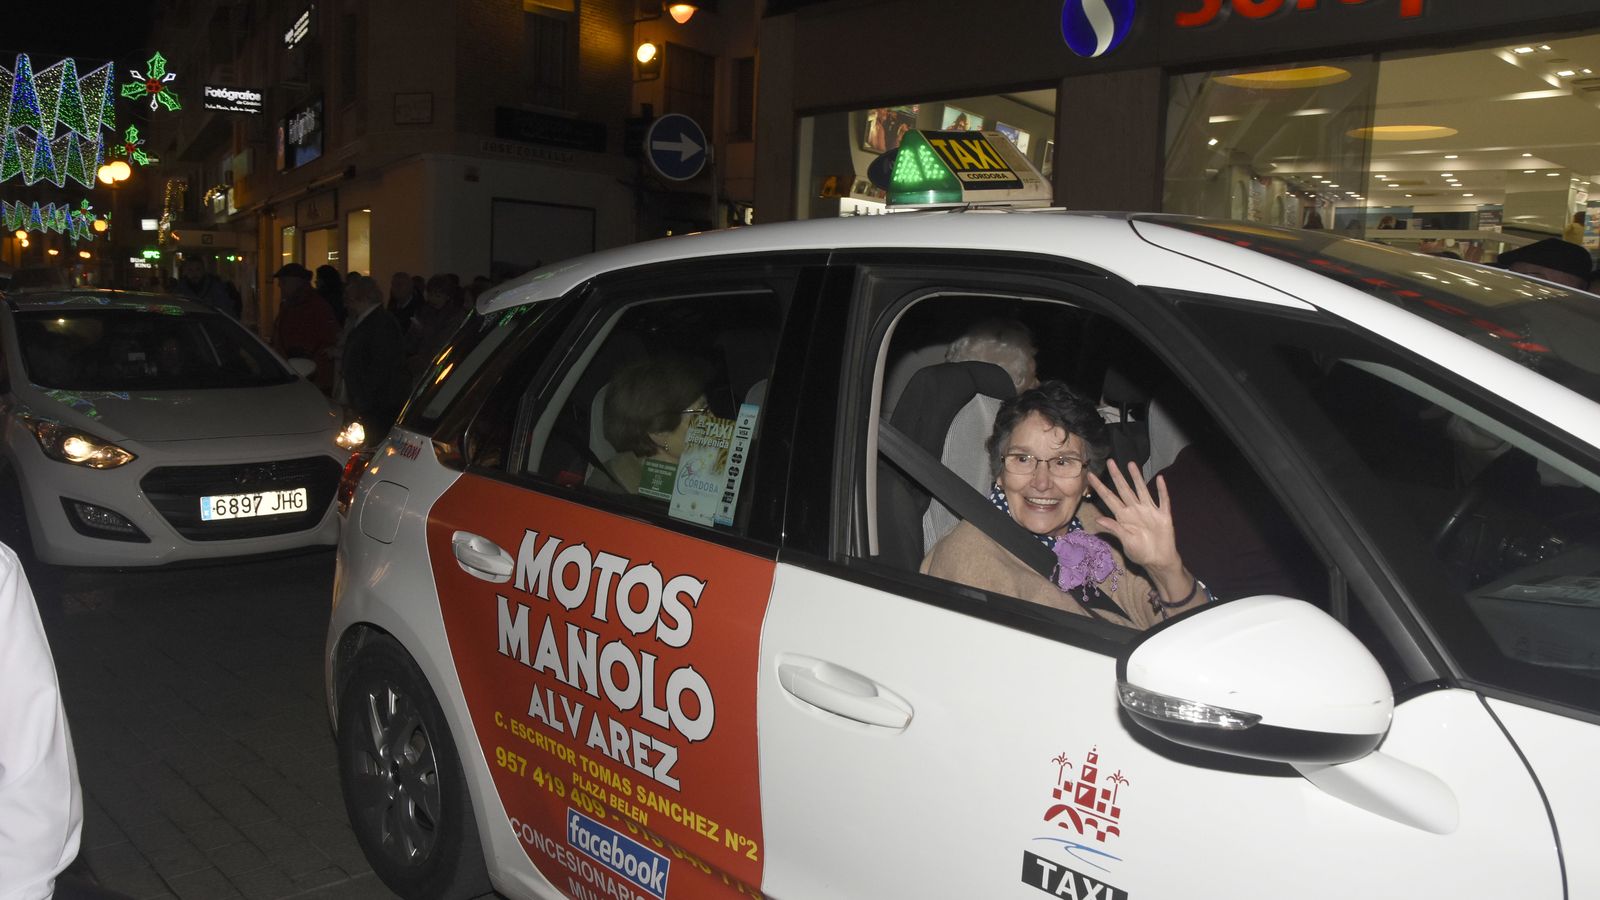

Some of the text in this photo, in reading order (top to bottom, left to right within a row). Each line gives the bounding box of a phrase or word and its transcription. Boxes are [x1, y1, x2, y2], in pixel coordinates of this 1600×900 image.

[205, 86, 261, 101] Fotógrafos
[929, 139, 1009, 170] TAXI
[705, 422, 734, 441] TAXI
[216, 492, 303, 516] 6897 JHG
[513, 528, 708, 648] MOTOS
[496, 593, 715, 743] MANOLO
[527, 683, 681, 792] ALVAREZ
[495, 711, 508, 730] C.
[510, 718, 577, 767] ESCRITOR
[579, 754, 632, 796] TOMAS
[636, 784, 720, 842] SANCHEZ
[495, 746, 528, 777] 957
[533, 766, 566, 798] 419
[571, 787, 606, 818] 409
[573, 772, 648, 826] PLAZA BELEN
[510, 817, 646, 900] CONCESIONAR
[569, 814, 665, 894] facebook
